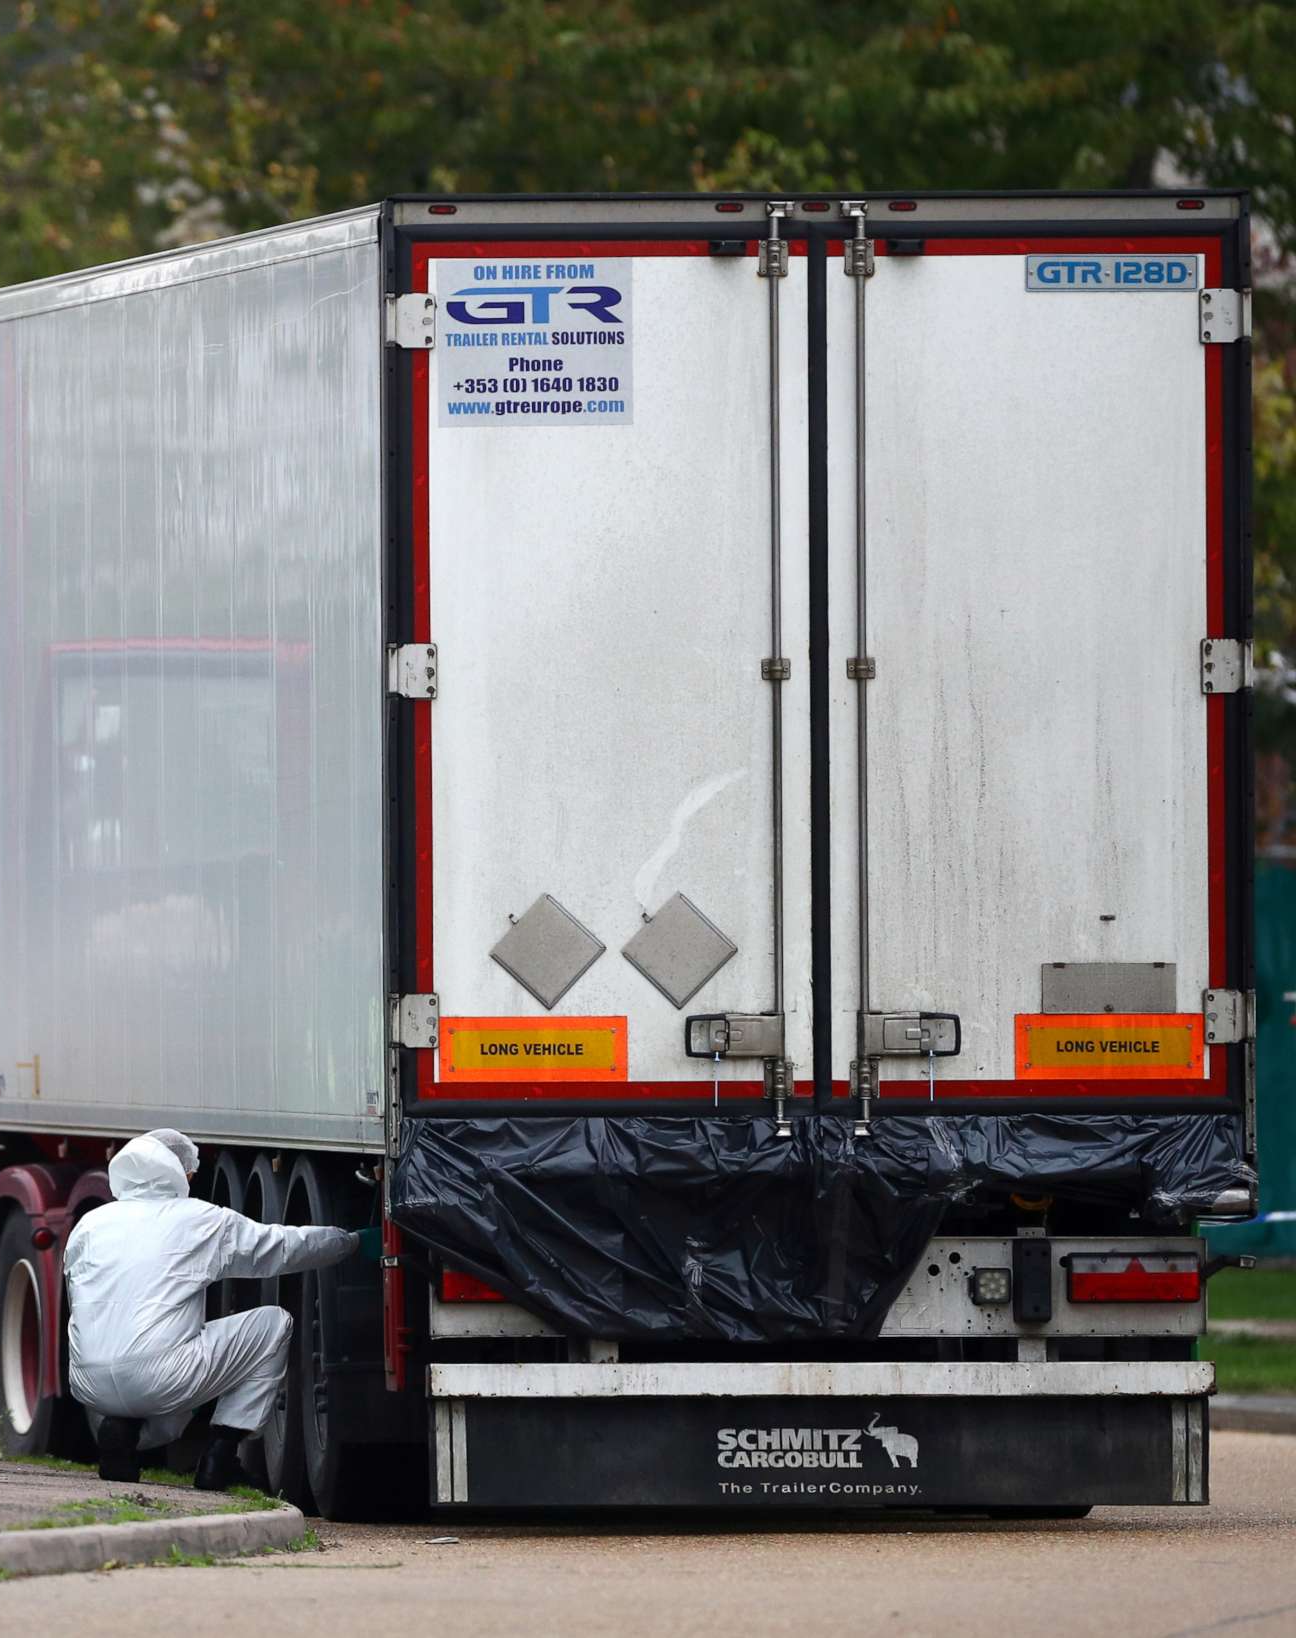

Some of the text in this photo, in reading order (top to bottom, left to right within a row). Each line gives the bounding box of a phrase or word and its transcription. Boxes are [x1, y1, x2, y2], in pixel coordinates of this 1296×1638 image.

[474, 264, 594, 280] ON HIRE FROM
[1037, 262, 1187, 283] GTR 128D
[446, 286, 623, 324] GTR
[445, 331, 624, 346] TRAILER RENTAL SOLUTIONS
[509, 357, 563, 371] Phone
[454, 377, 619, 393] +353 (0) 1640 1830
[448, 400, 624, 415] www.gtreurope.com
[480, 1044, 583, 1055] LONG VEHICLE
[1056, 1041, 1159, 1053] LONG VEHICLE
[717, 1428, 862, 1450] SCHMITZ
[717, 1451, 862, 1468] CARGOBULL
[719, 1483, 753, 1494] The
